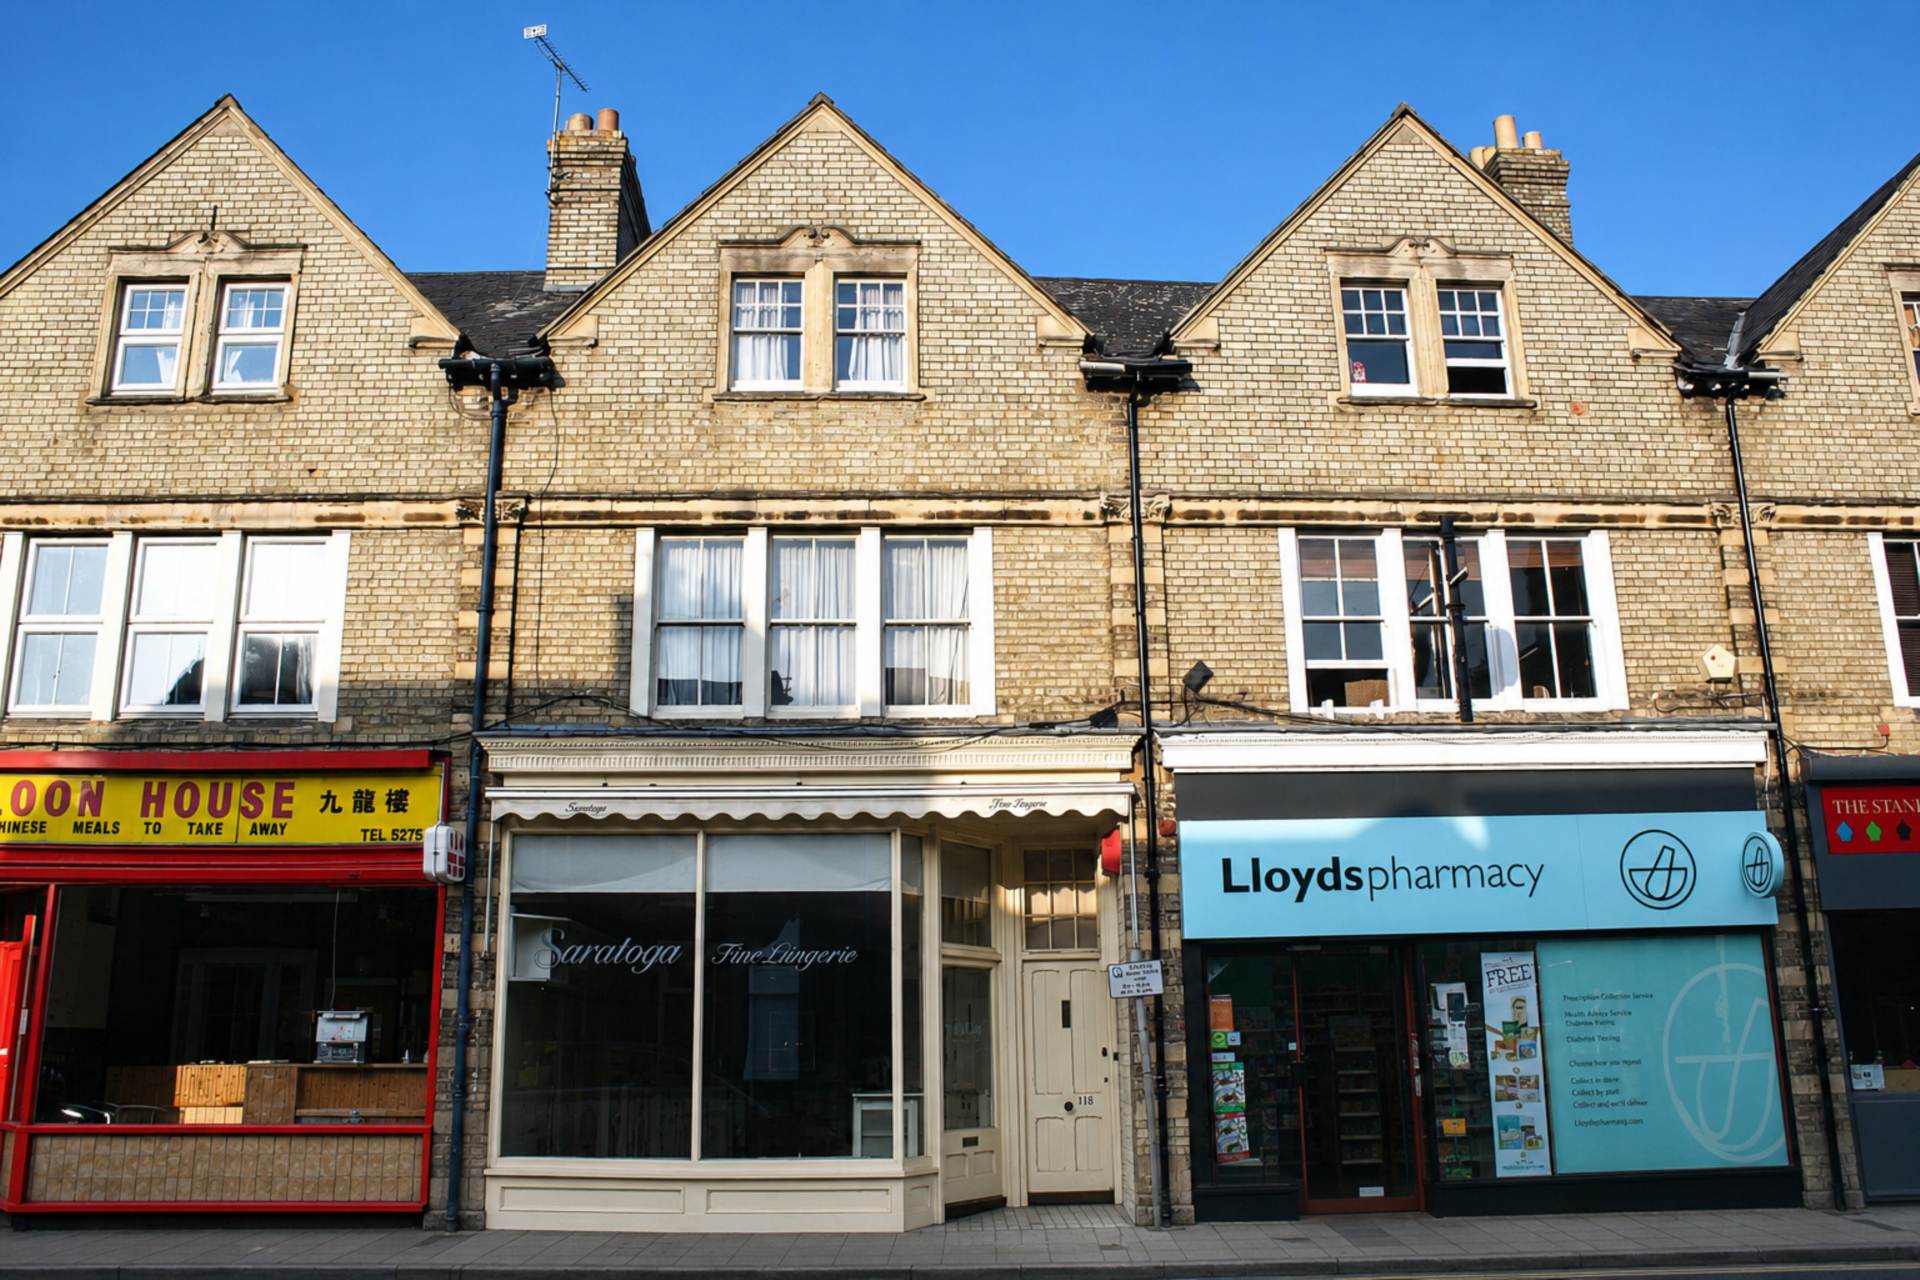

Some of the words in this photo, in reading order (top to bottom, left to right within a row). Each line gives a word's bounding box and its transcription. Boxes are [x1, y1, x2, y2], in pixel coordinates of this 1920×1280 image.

[0, 779, 104, 817] OON
[140, 780, 296, 819] HOUSE
[319, 788, 410, 814] 九龍樓
[1832, 799, 1870, 814] THE
[72, 820, 120, 835] MEALS
[143, 821, 162, 835] TO
[187, 821, 224, 836] TAKE
[249, 822, 287, 836] AWAY
[360, 828, 387, 842] TEL
[391, 828, 423, 842] 5275
[1221, 855, 1545, 903] Lloydspharmacy
[535, 927, 685, 974] Saratoga
[711, 942, 763, 965] Fine
[1486, 963, 1532, 988] FREE
[1078, 1095, 1094, 1106] 118
